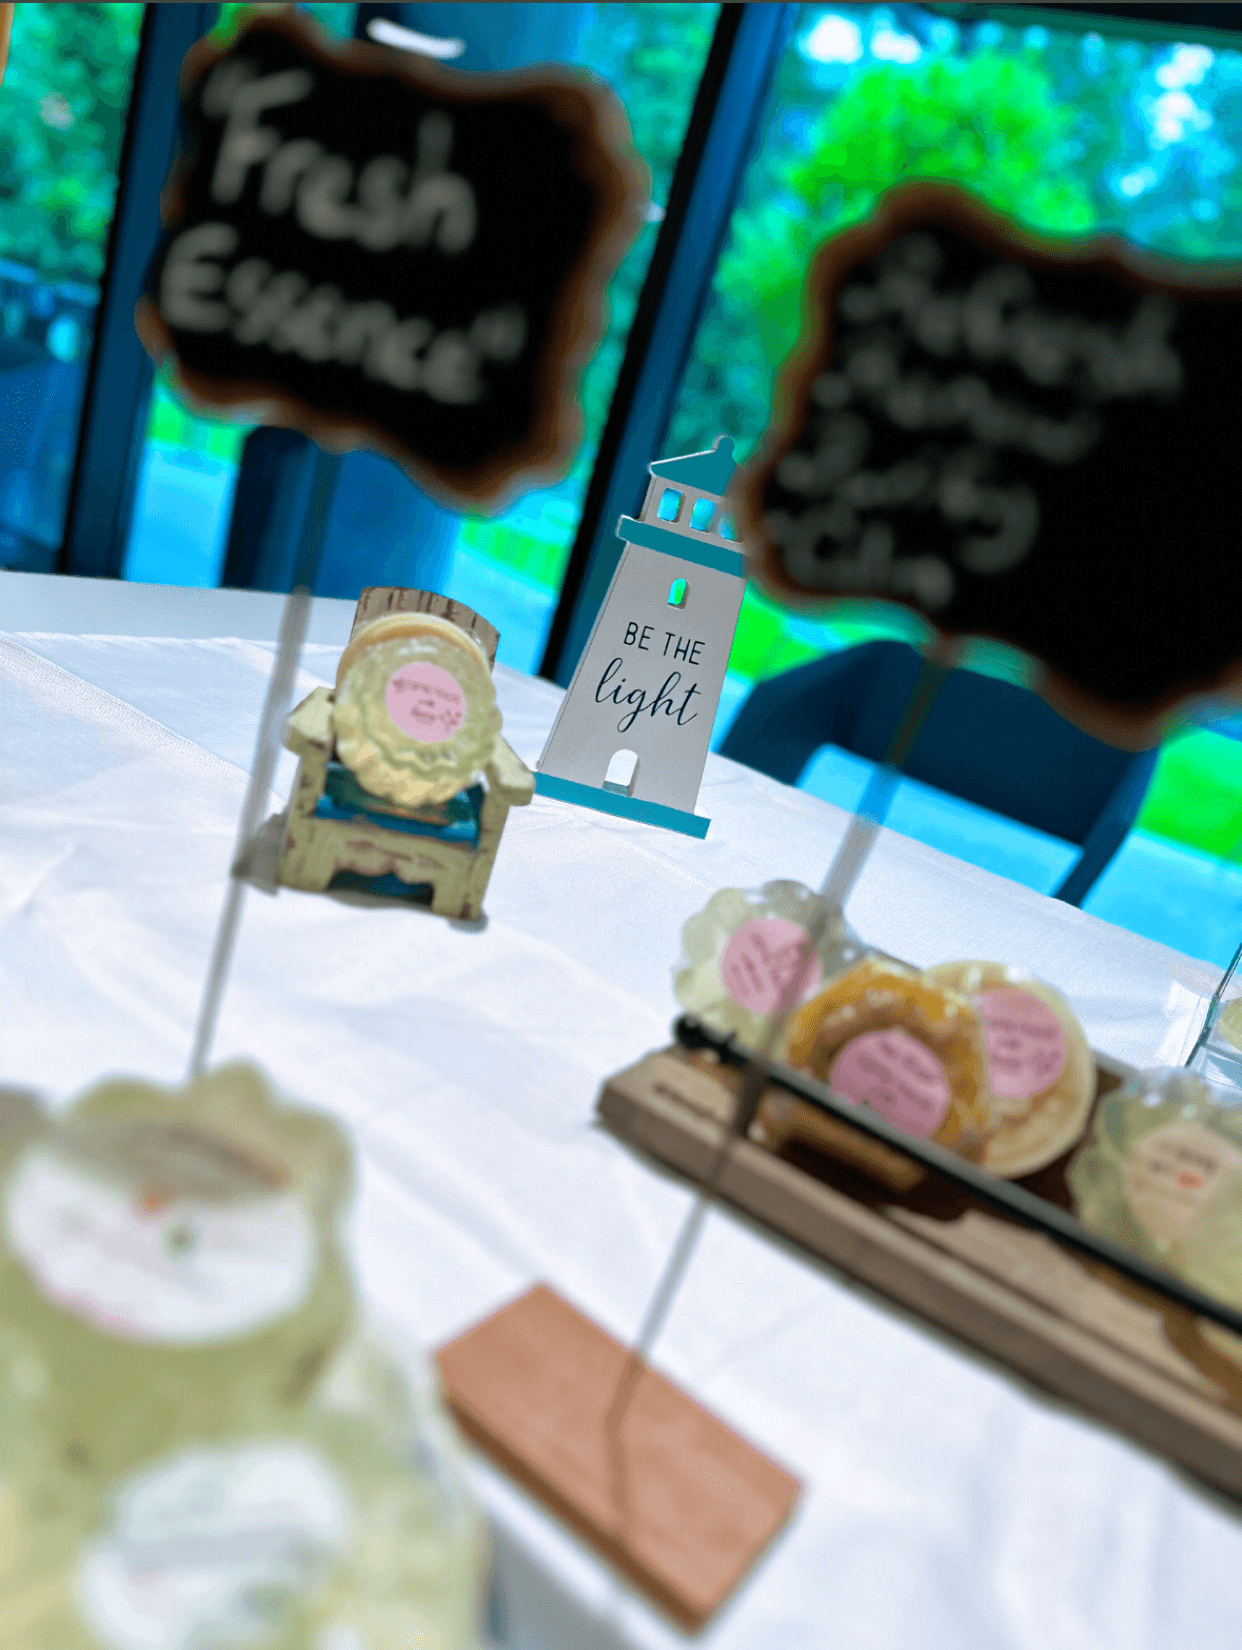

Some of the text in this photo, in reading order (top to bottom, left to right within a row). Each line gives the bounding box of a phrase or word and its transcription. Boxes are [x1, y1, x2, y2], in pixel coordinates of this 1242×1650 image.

[623, 621, 706, 666] BE THE
[594, 657, 702, 733] light
